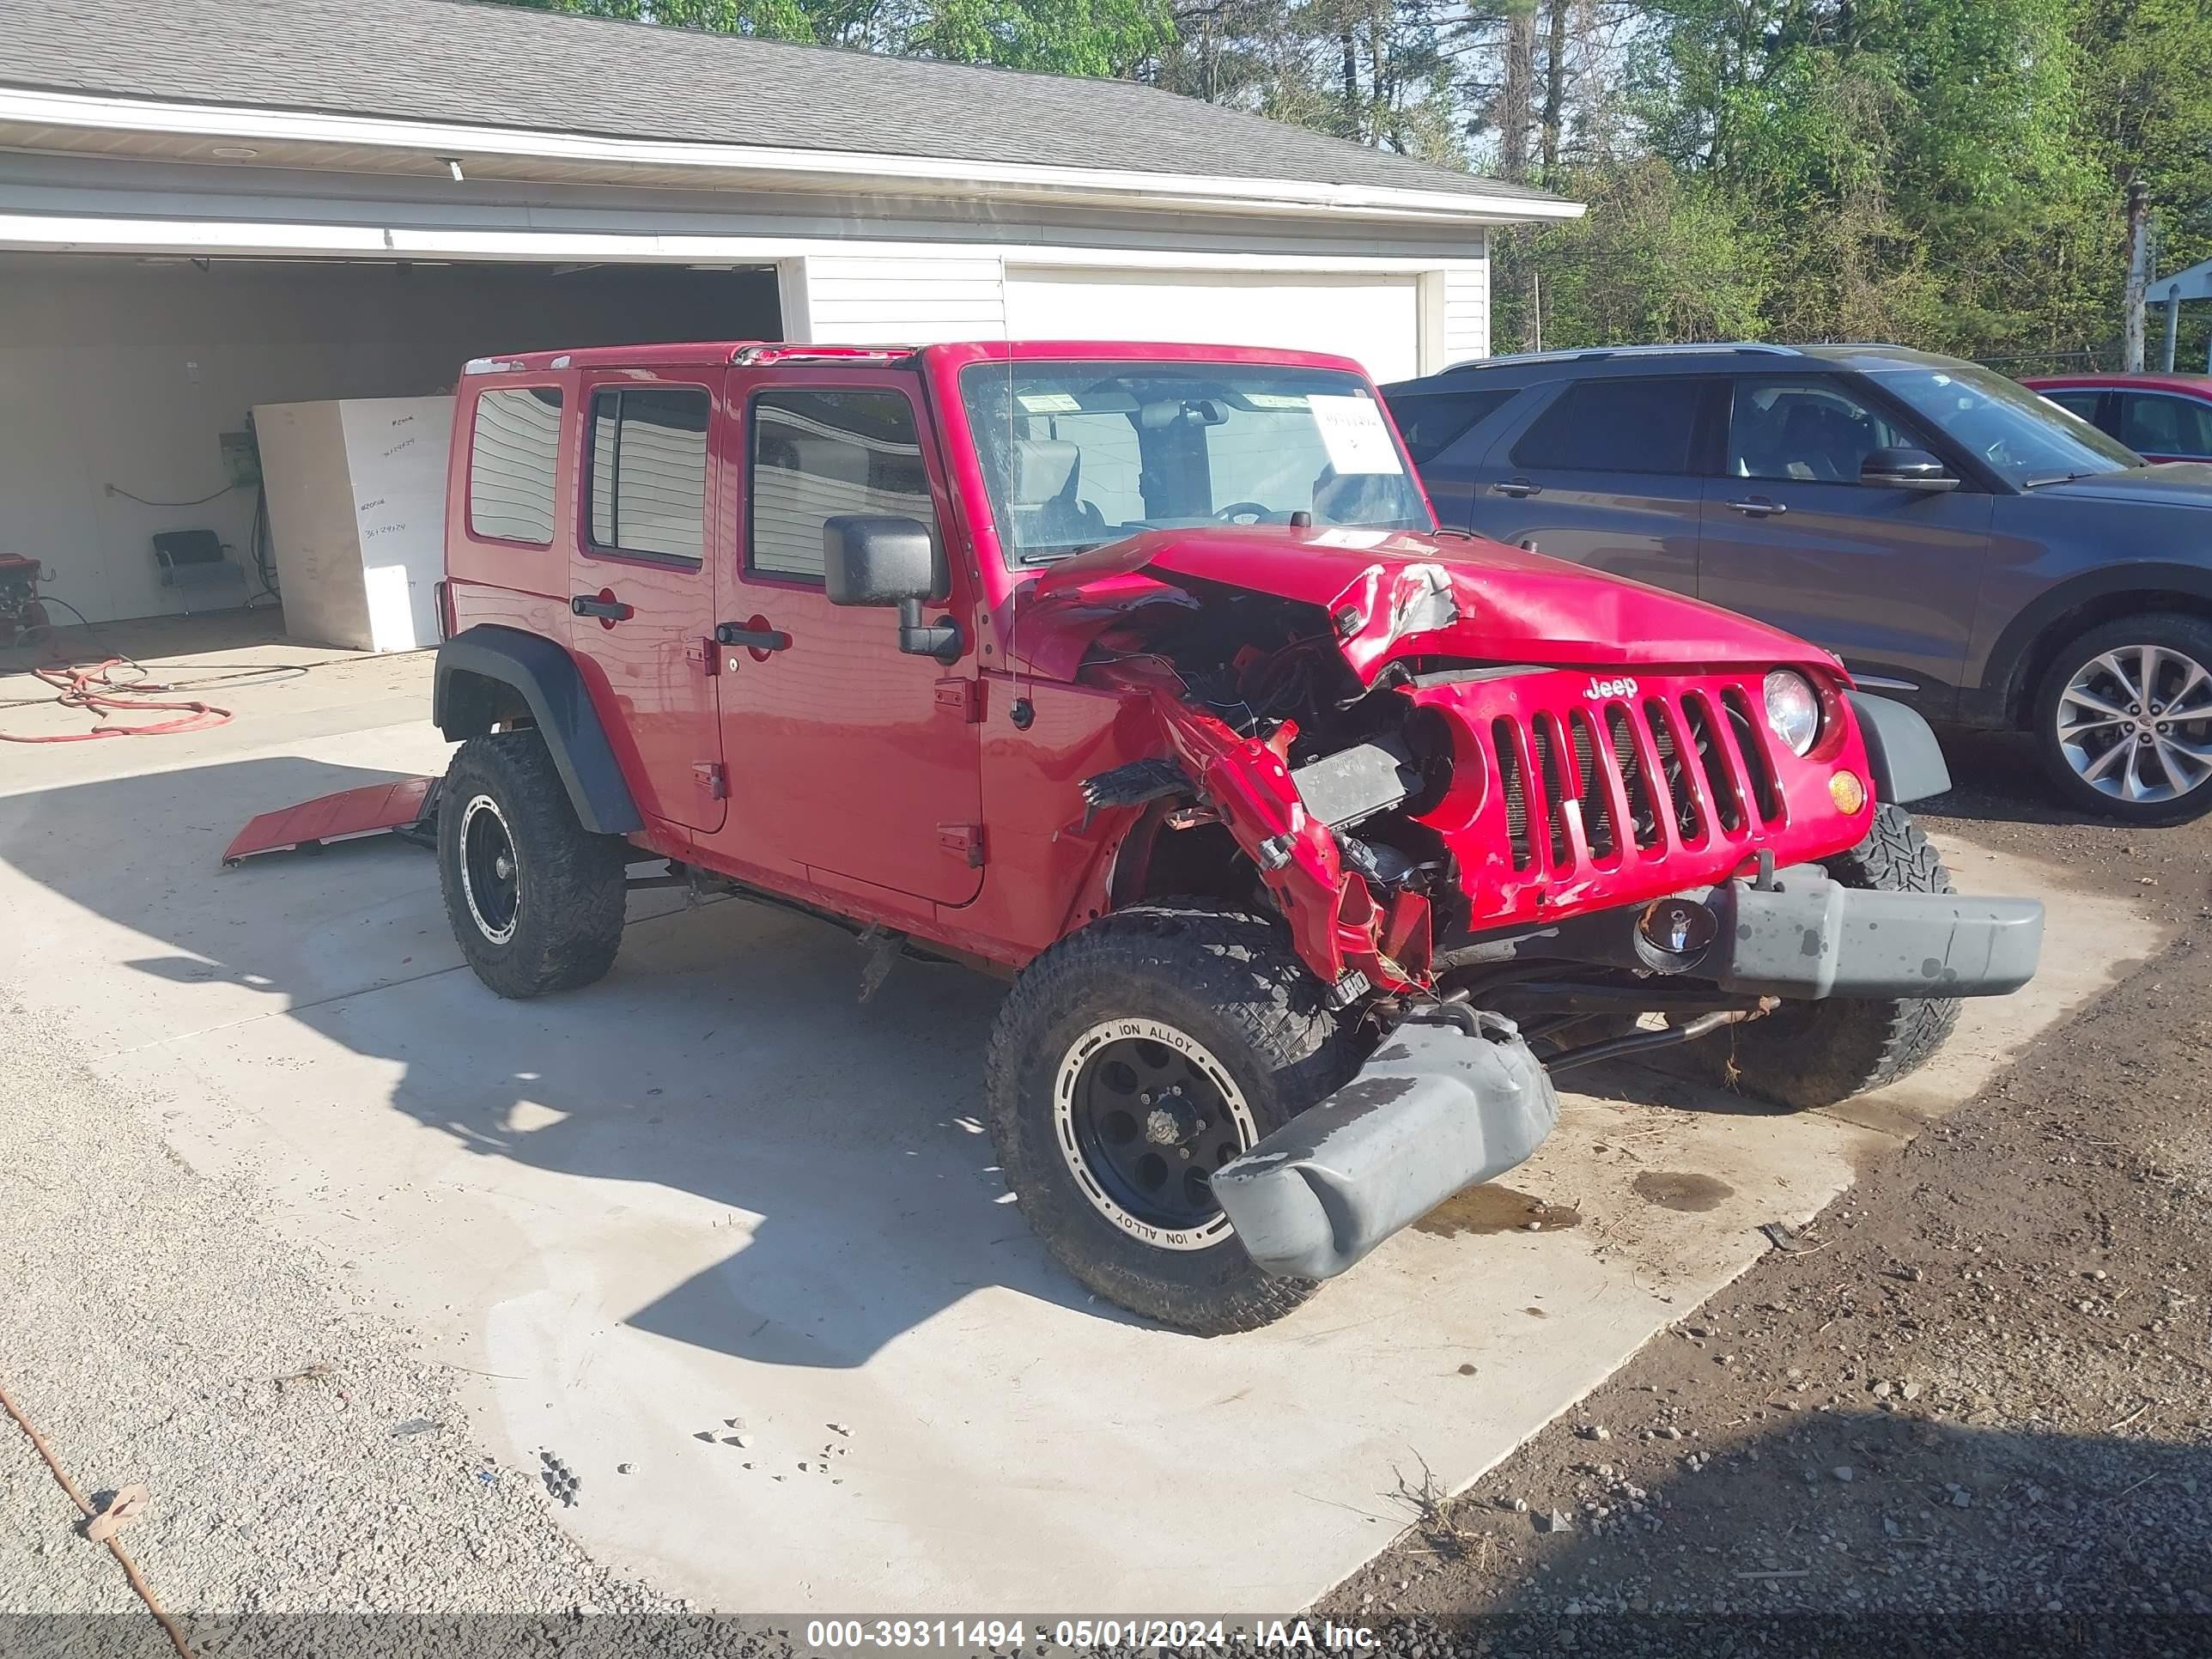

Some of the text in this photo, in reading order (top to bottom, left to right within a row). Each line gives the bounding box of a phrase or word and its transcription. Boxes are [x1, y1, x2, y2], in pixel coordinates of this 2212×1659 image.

[1585, 676, 1639, 700] Jeep
[1119, 1024, 1193, 1054] ION ALLOY
[1115, 1212, 1188, 1244] ION ALLOY
